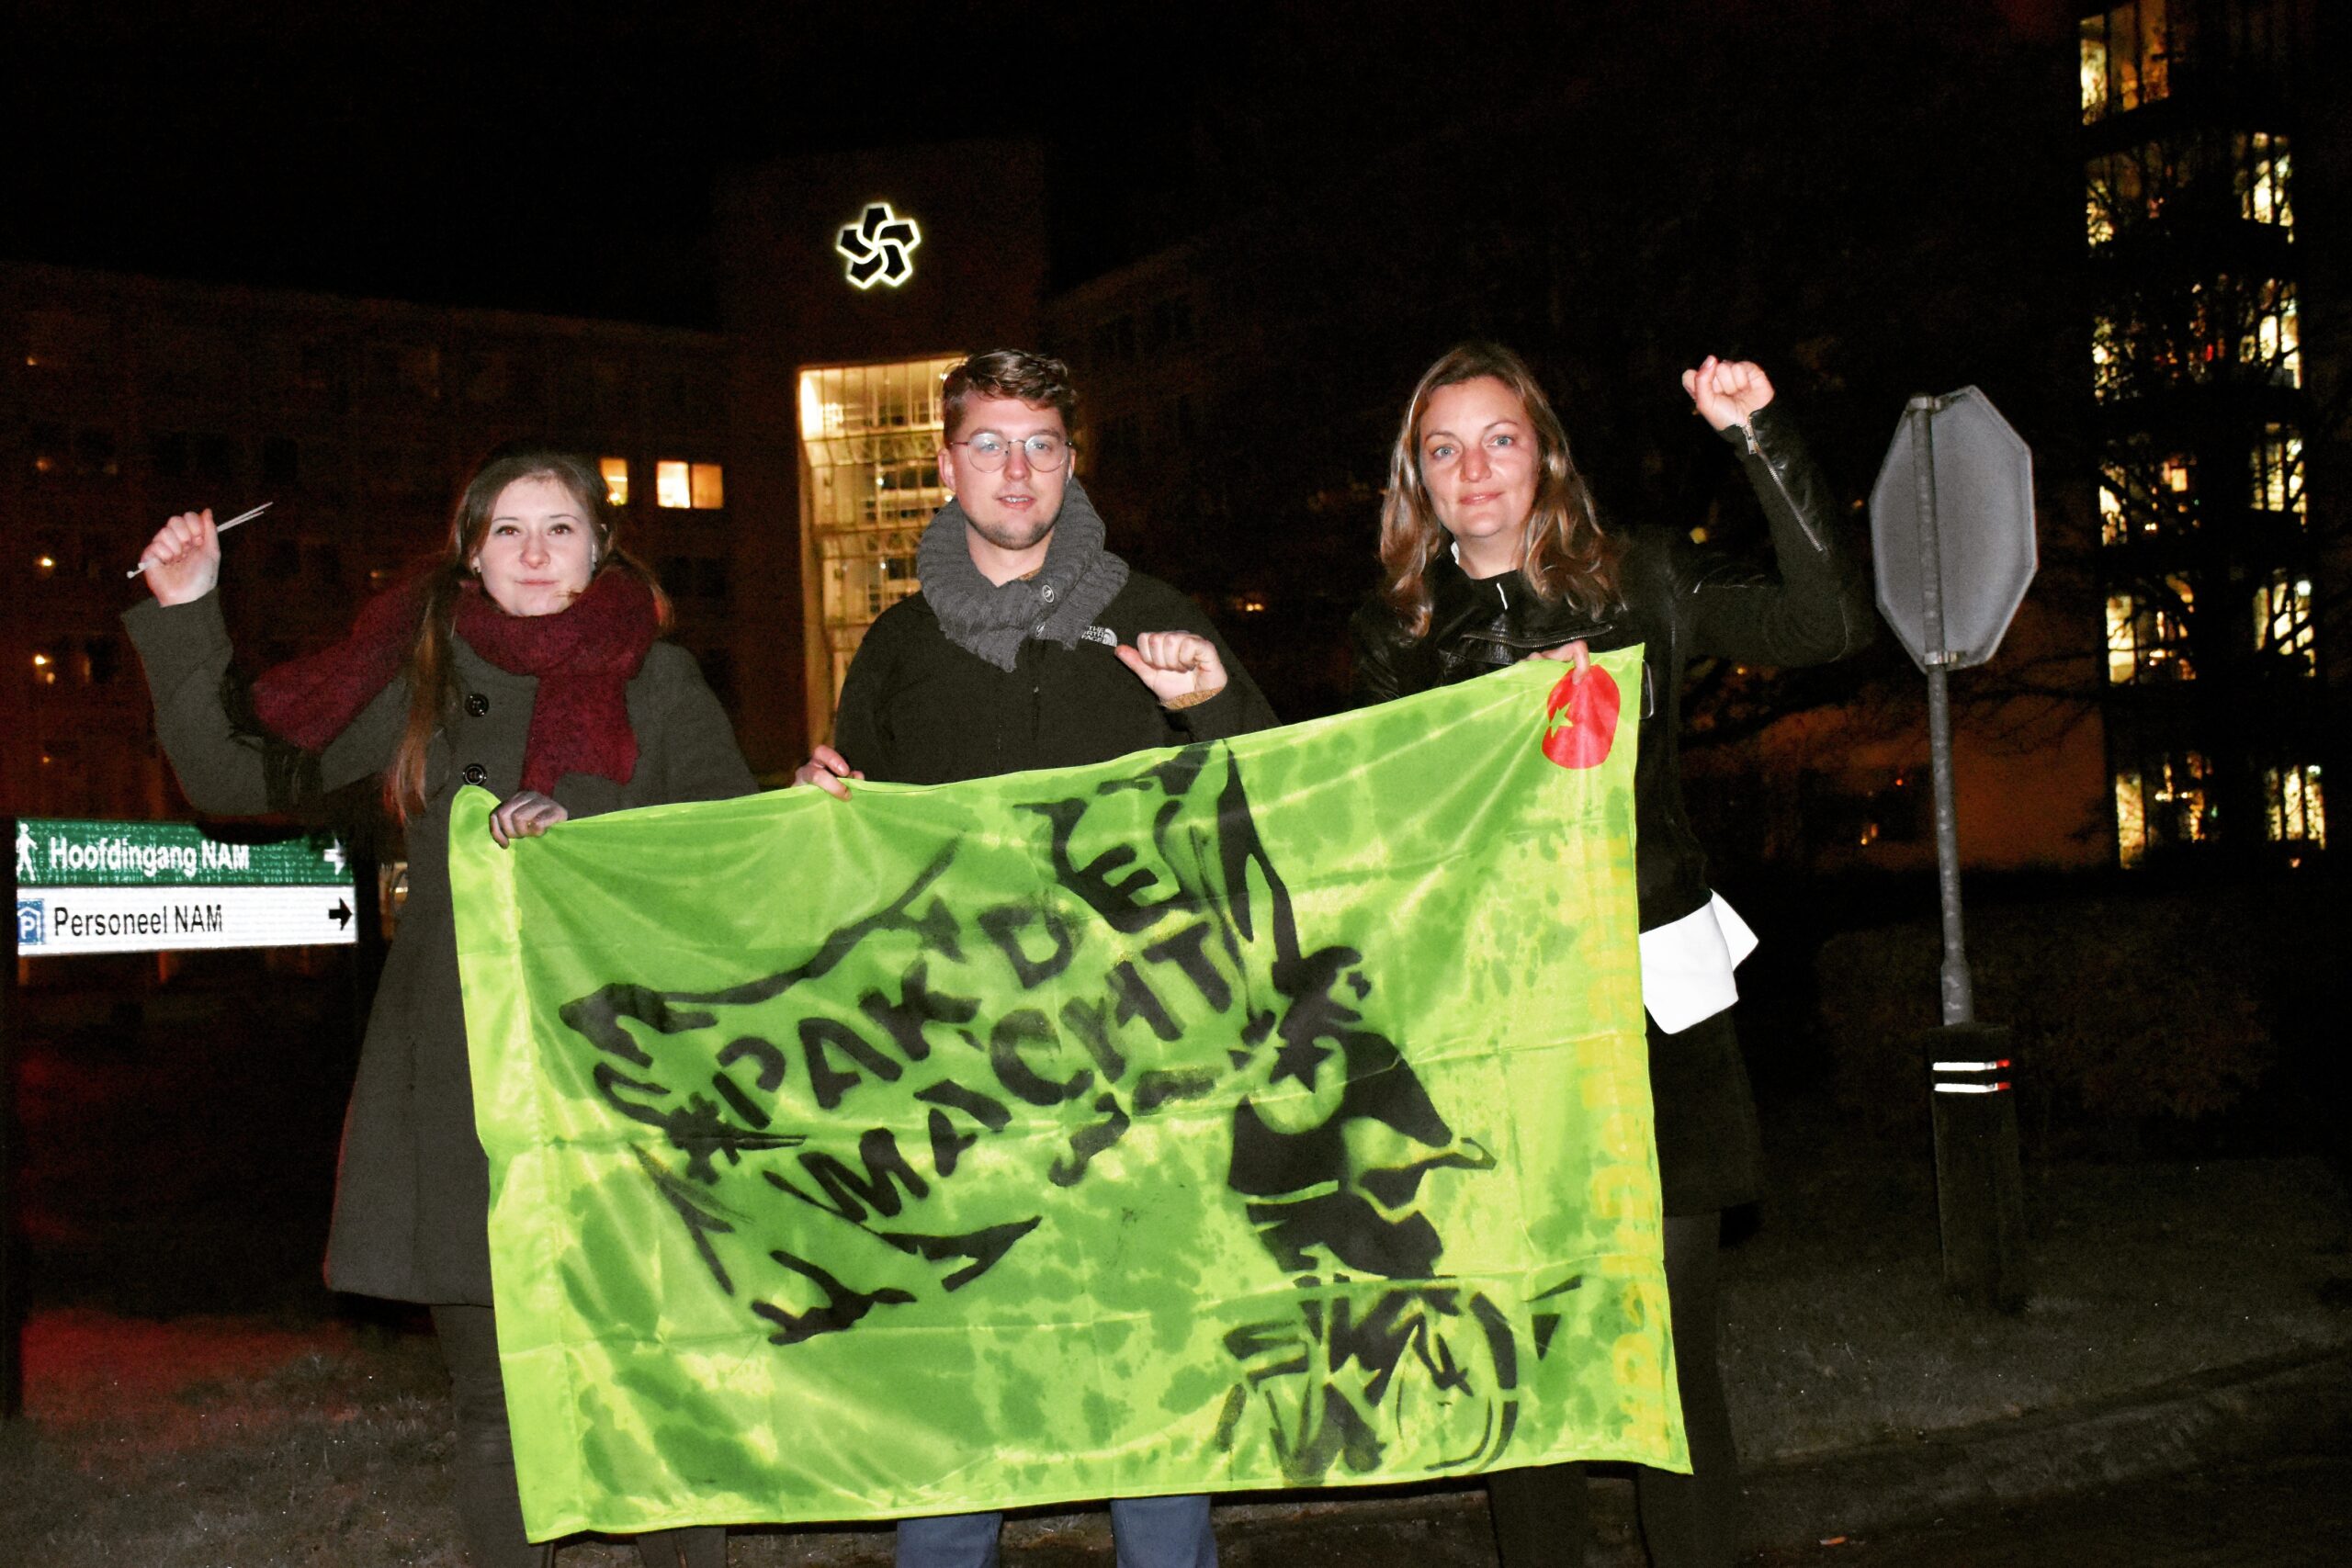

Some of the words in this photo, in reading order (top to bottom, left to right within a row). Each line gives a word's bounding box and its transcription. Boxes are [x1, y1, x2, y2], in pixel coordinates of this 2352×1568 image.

[1080, 634, 1103, 644] FACE
[50, 837, 198, 877] Hoofdingang
[201, 839, 251, 870] NAM
[54, 906, 168, 936] Personeel
[175, 904, 223, 933] NAM
[711, 952, 982, 1131] PAK
[977, 842, 1183, 991] DE
[797, 921, 1233, 1223] MACHT
